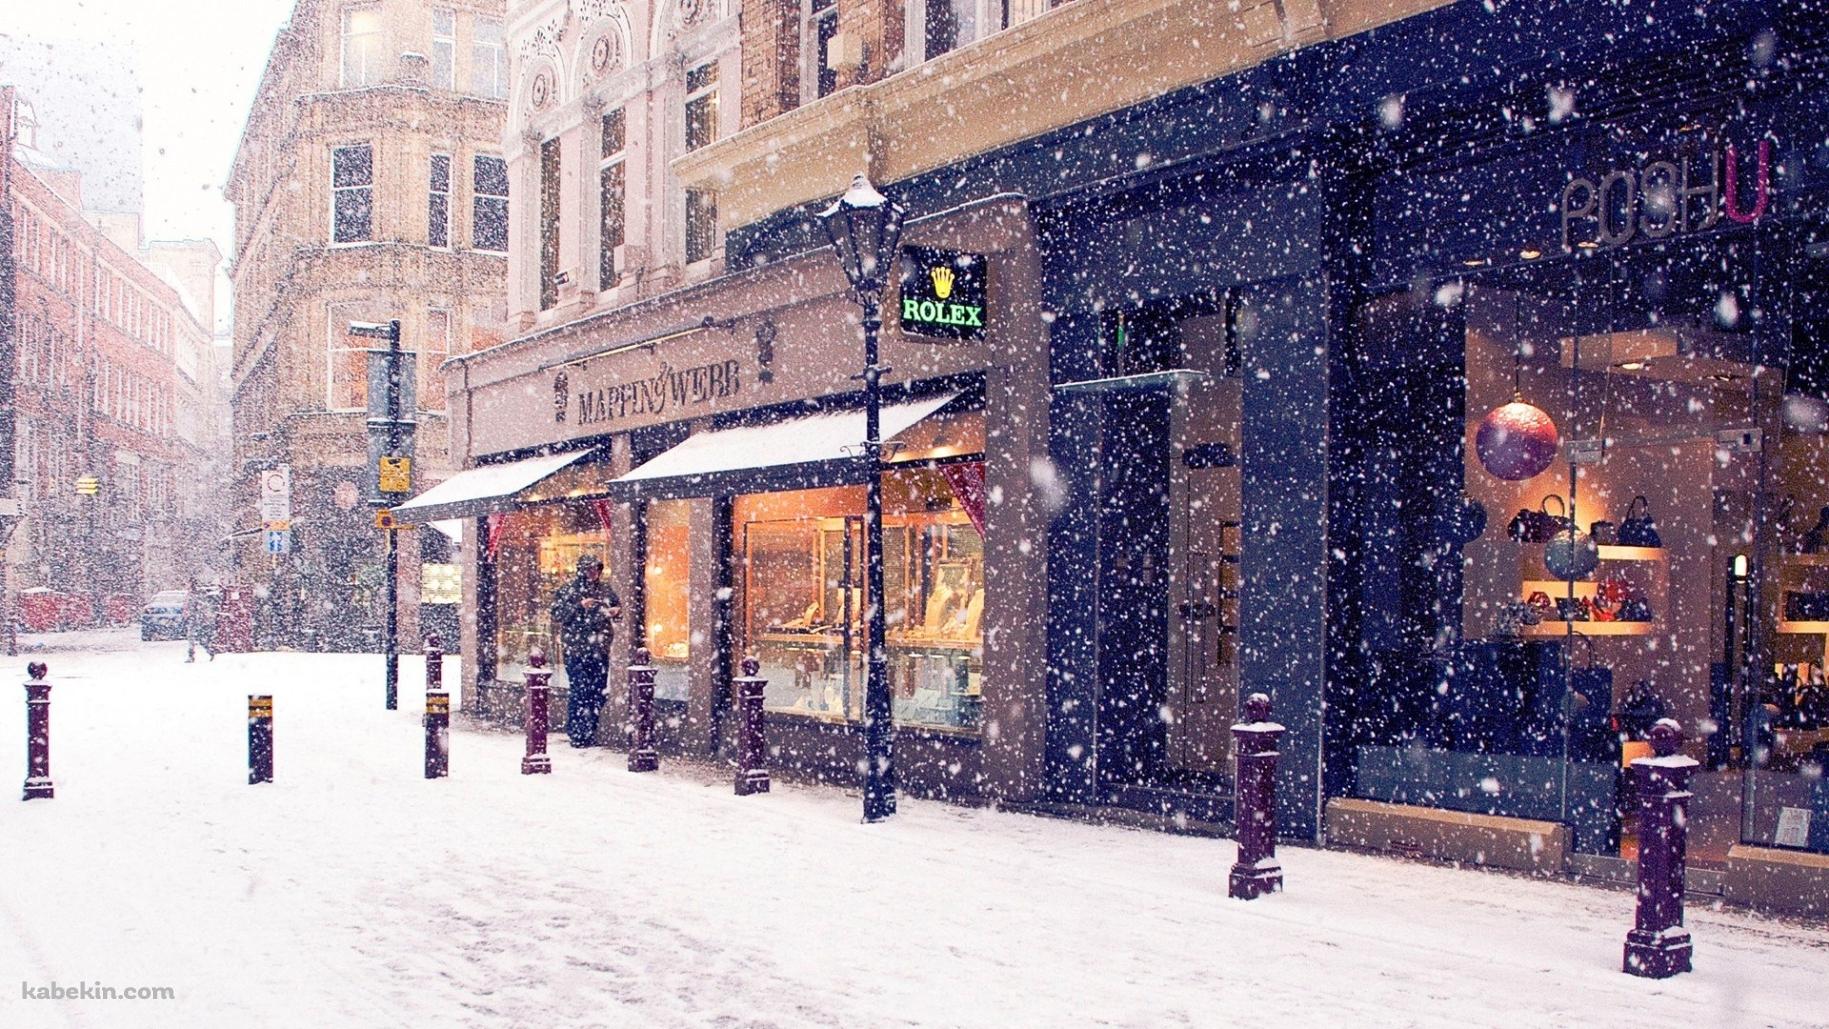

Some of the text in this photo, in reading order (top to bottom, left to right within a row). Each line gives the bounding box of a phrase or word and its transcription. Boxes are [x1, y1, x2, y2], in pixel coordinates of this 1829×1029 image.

[903, 299, 982, 326] ROLEX
[577, 378, 656, 426] MAPPIN
[670, 359, 740, 407] WEBB
